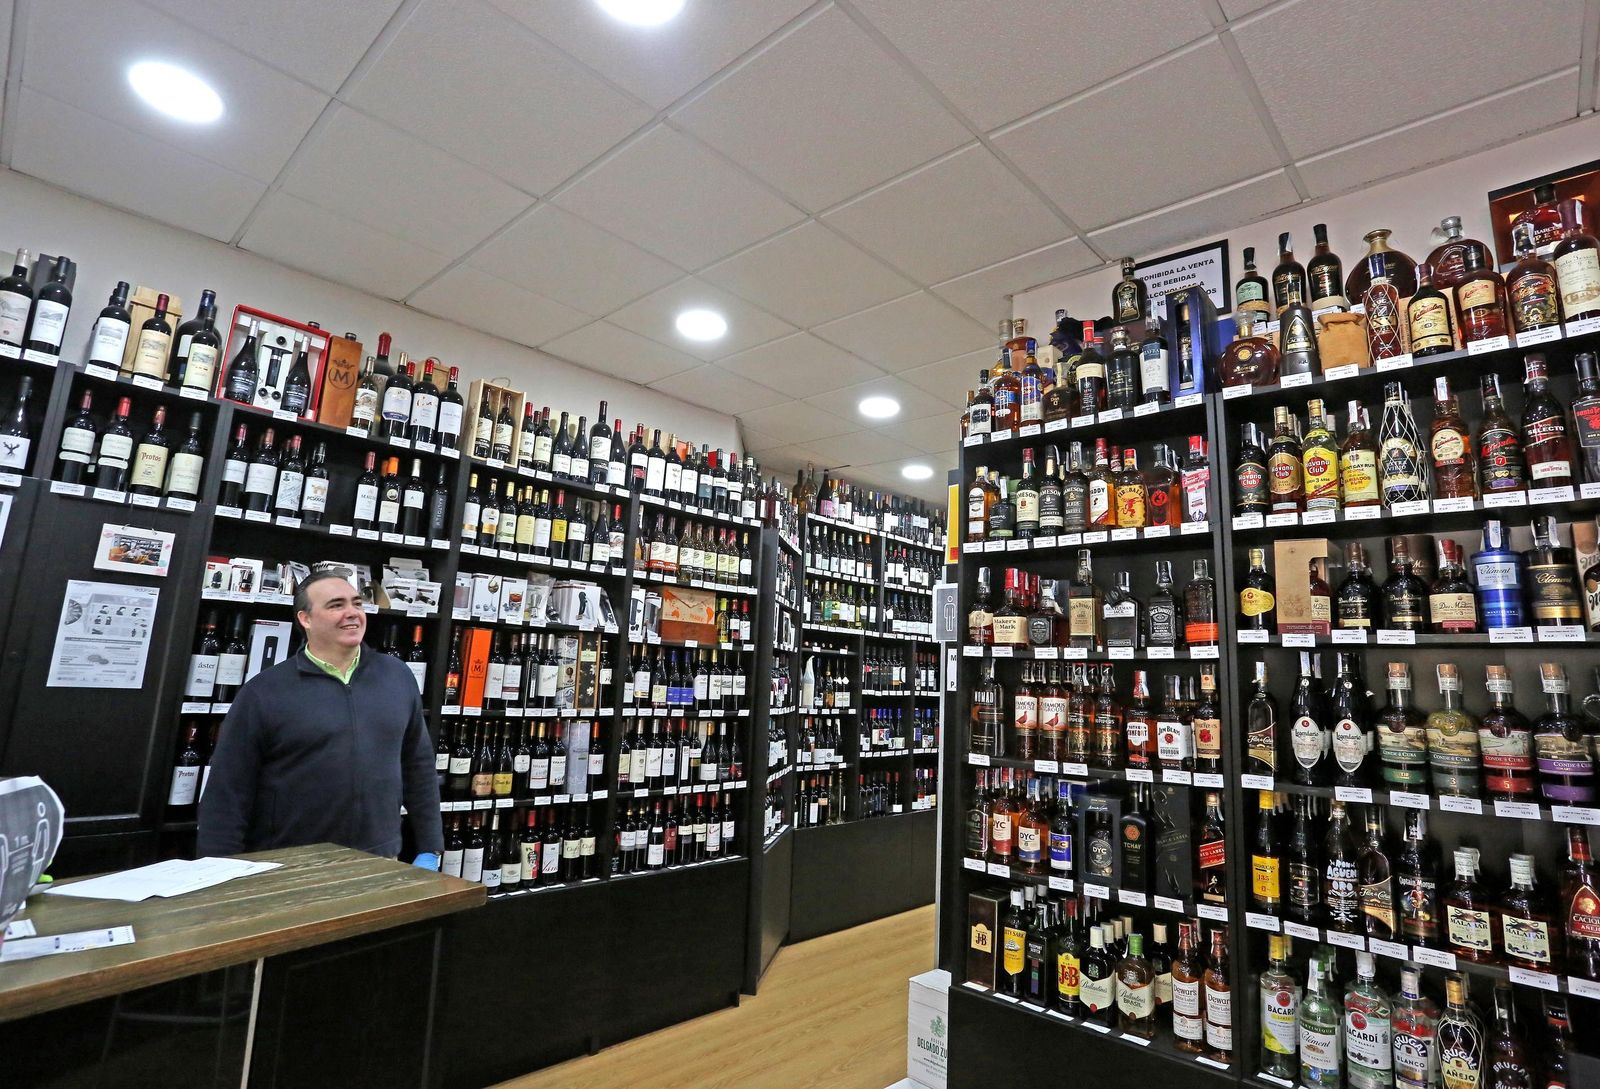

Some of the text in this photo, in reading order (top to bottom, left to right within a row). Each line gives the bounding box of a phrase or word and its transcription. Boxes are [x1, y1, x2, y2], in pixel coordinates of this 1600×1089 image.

[1139, 269, 1174, 282] ROHIBIDA
[1188, 258, 1214, 270] VENTA
[1164, 272, 1196, 286] BEBIDAS
[333, 371, 350, 386] M
[140, 450, 162, 462] Protos
[1309, 464, 1324, 474] Club
[1332, 880, 1354, 891] ORO
[1174, 984, 1198, 996] Dewar's
[917, 1036, 940, 1056] DELGADO
[1394, 1033, 1428, 1058] BRUGAL
[1396, 1056, 1426, 1068] BLANCO
[1442, 1048, 1478, 1070] BRUGAL
[1446, 1068, 1476, 1082] AÑEJO
